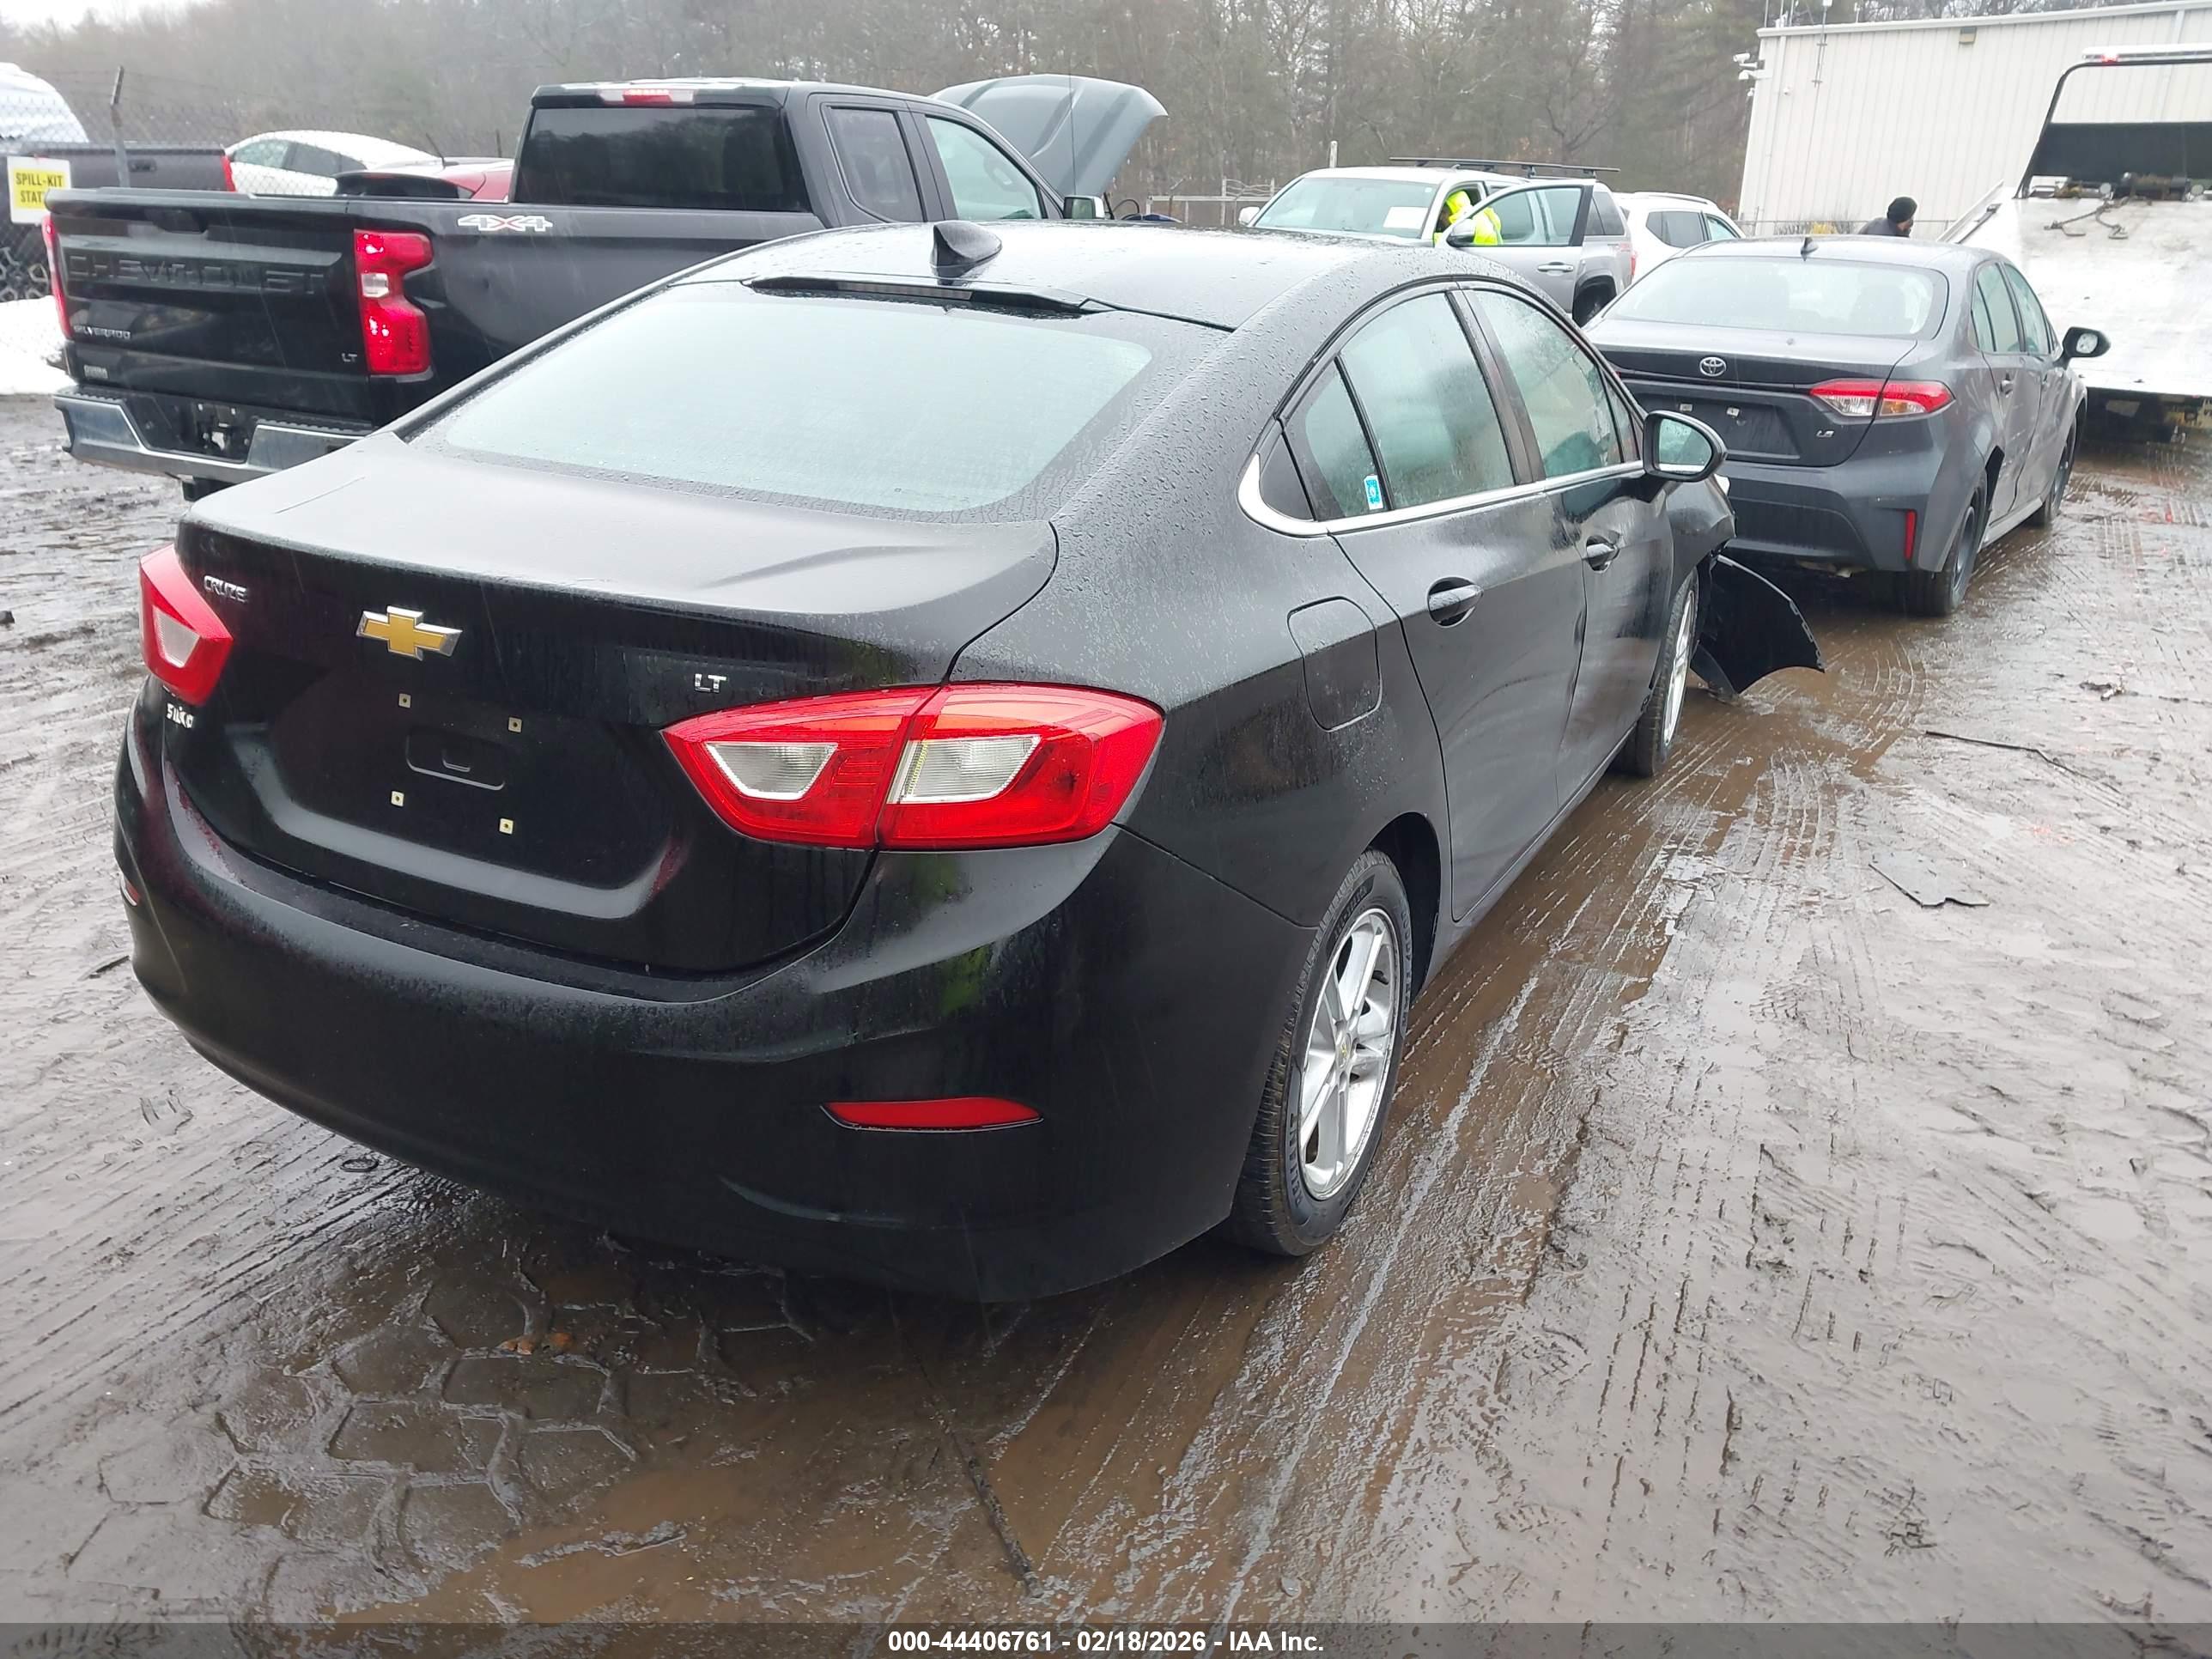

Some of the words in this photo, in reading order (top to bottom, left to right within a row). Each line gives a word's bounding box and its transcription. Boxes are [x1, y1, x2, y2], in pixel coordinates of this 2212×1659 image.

[15, 173, 64, 187] SPILL-KIT
[20, 190, 43, 203] STAT
[69, 256, 325, 295] CHEVROLET
[74, 325, 131, 340] SILVERADO
[341, 352, 358, 362] LT
[204, 575, 247, 603] CRUZE
[695, 673, 727, 693] LT
